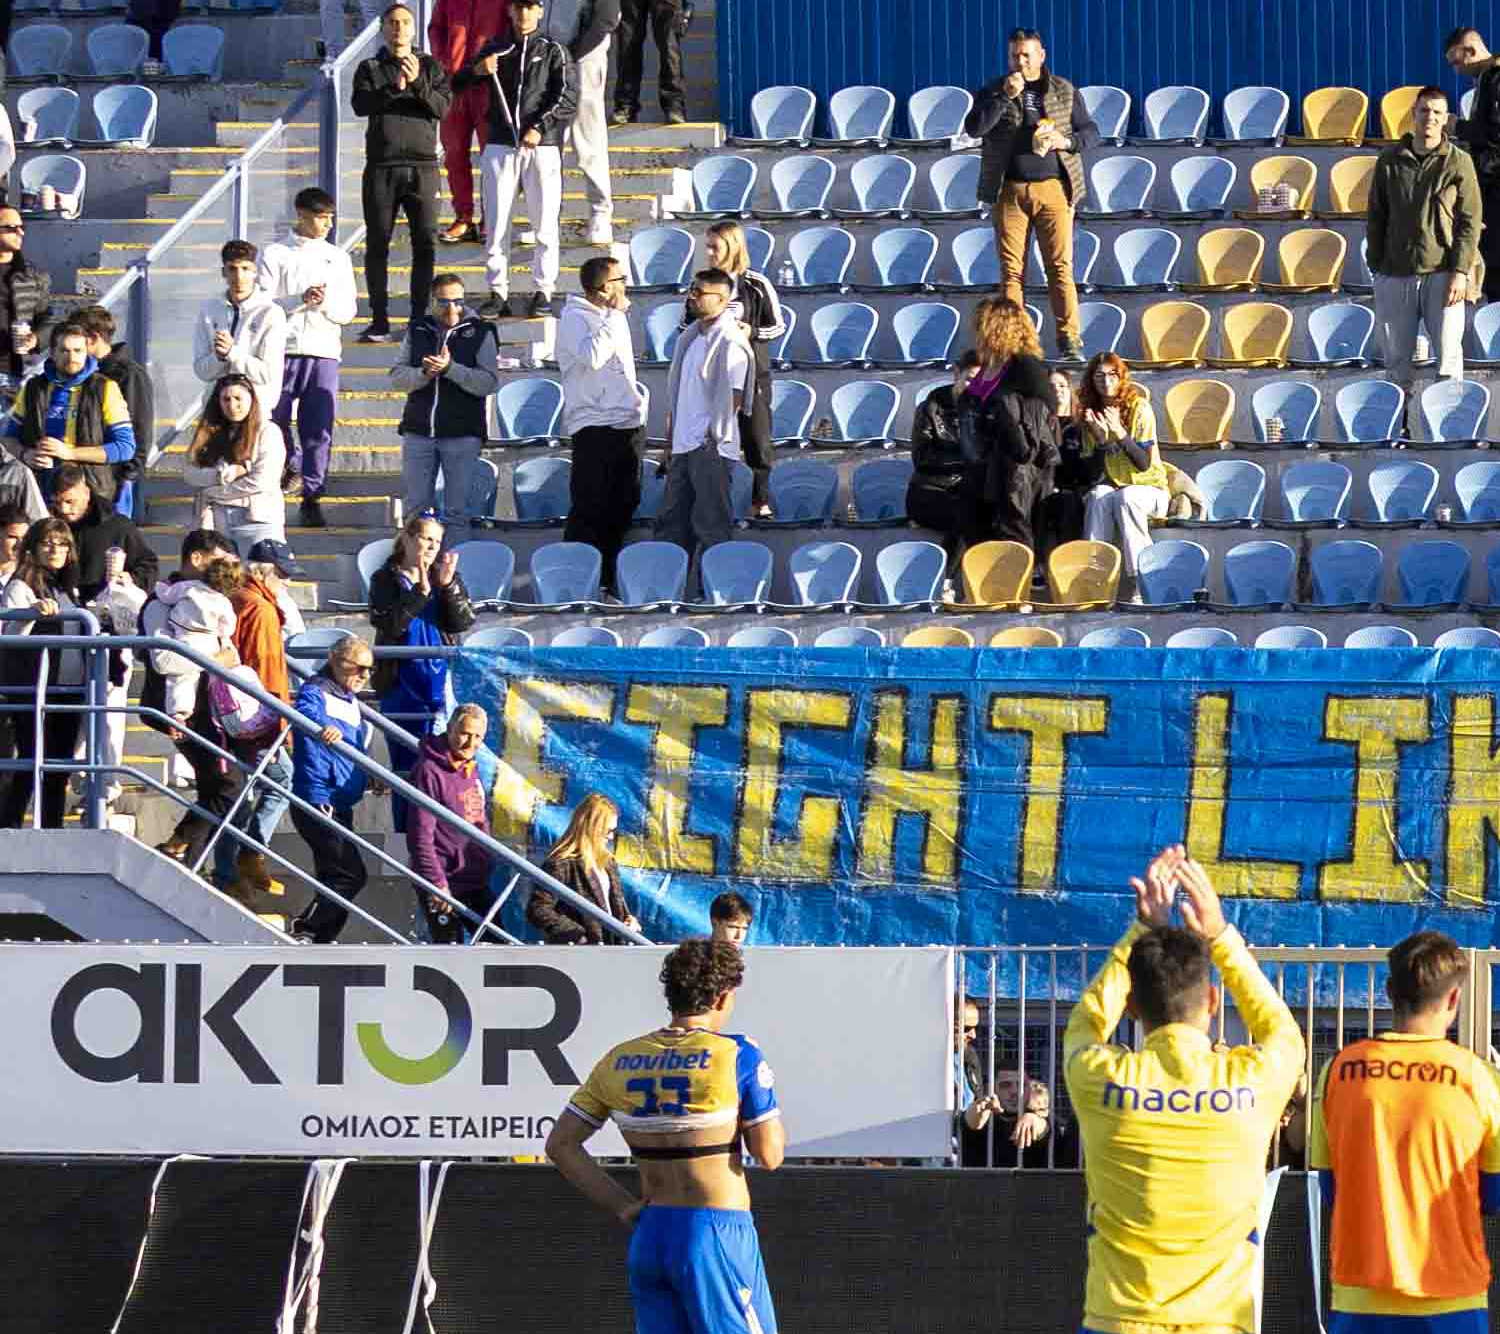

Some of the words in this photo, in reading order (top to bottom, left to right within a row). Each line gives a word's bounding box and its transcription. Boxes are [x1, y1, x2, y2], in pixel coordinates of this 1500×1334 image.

[490, 677, 1108, 897] FIGHT
[614, 1048, 712, 1069] novibet
[1339, 1058, 1456, 1085] macron
[1102, 1081, 1255, 1114] macron
[302, 1114, 420, 1139] ΟΜΙΛΟΣ
[430, 1114, 553, 1140] ΕΤΑΙΡΕΙΩ
